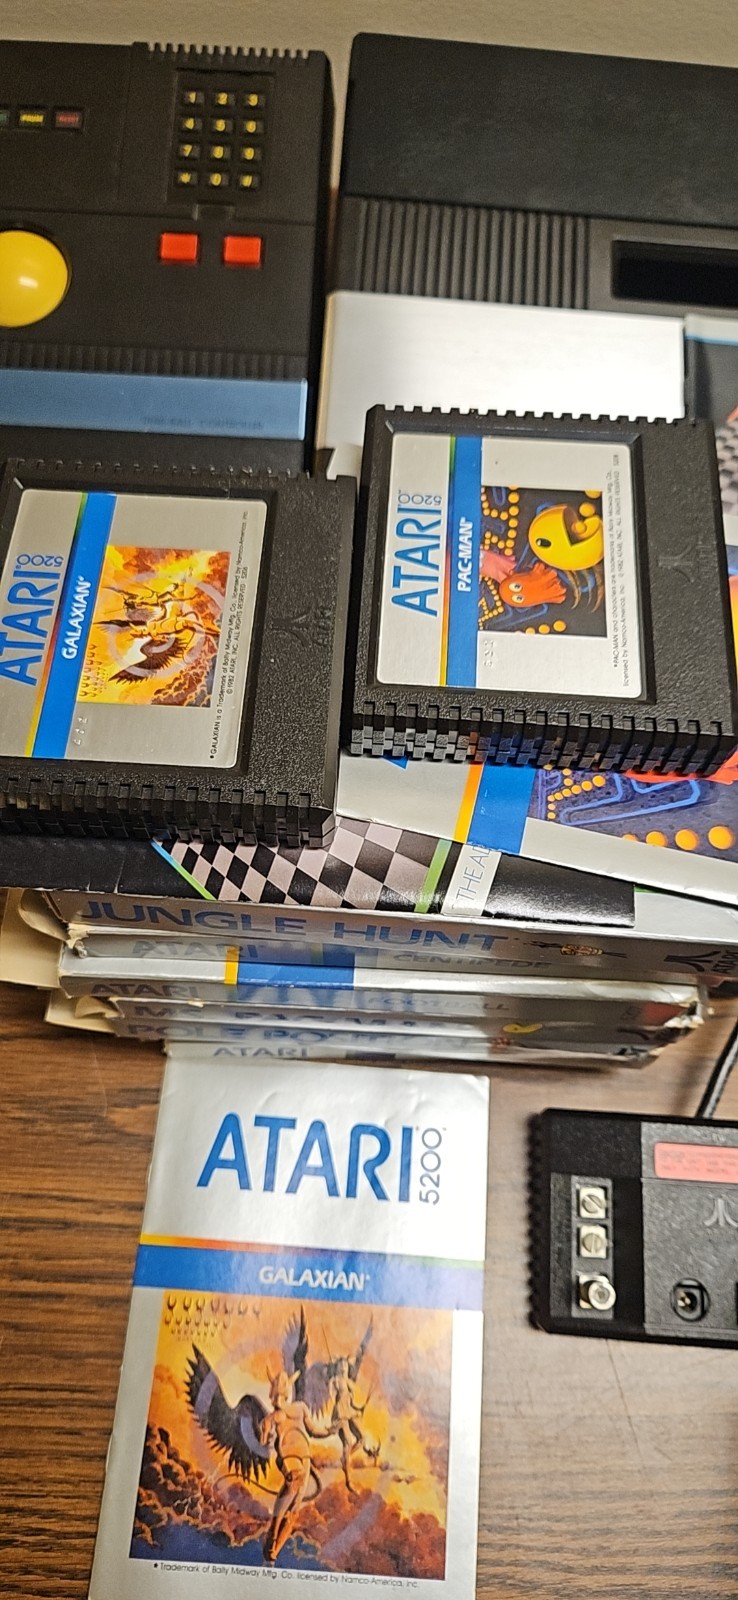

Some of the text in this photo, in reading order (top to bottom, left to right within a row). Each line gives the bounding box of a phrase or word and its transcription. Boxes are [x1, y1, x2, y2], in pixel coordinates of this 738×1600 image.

[217, 92, 228, 105] 2
[182, 144, 193, 157] 7
[398, 492, 442, 507] 5200
[16, 553, 64, 568] 5200
[391, 506, 442, 618] ATARI
[456, 520, 474, 593] PAC-MAN
[0, 570, 61, 686] ATARI
[61, 579, 92, 660] GALAXIAN
[224, 627, 234, 650] Midway
[222, 651, 231, 666] Bally
[217, 675, 227, 707] Trademark
[210, 721, 221, 754] GALAXIAN
[456, 866, 484, 901] THE
[80, 900, 508, 951] JUNGLE HUNT
[132, 940, 259, 958] ATARI
[394, 953, 552, 970] CENTIPEDE
[92, 982, 200, 999] ATARI
[211, 1046, 310, 1058] ATARI
[196, 1111, 414, 1203] ATARI
[419, 1127, 443, 1206] 5200
[258, 1265, 366, 1292] GALAXIAN
[160, 1562, 200, 1573] Trademark
[201, 1565, 210, 1573] of
[212, 1566, 229, 1576] Bally
[231, 1567, 260, 1578] Midway
[297, 1572, 328, 1582] licensed
